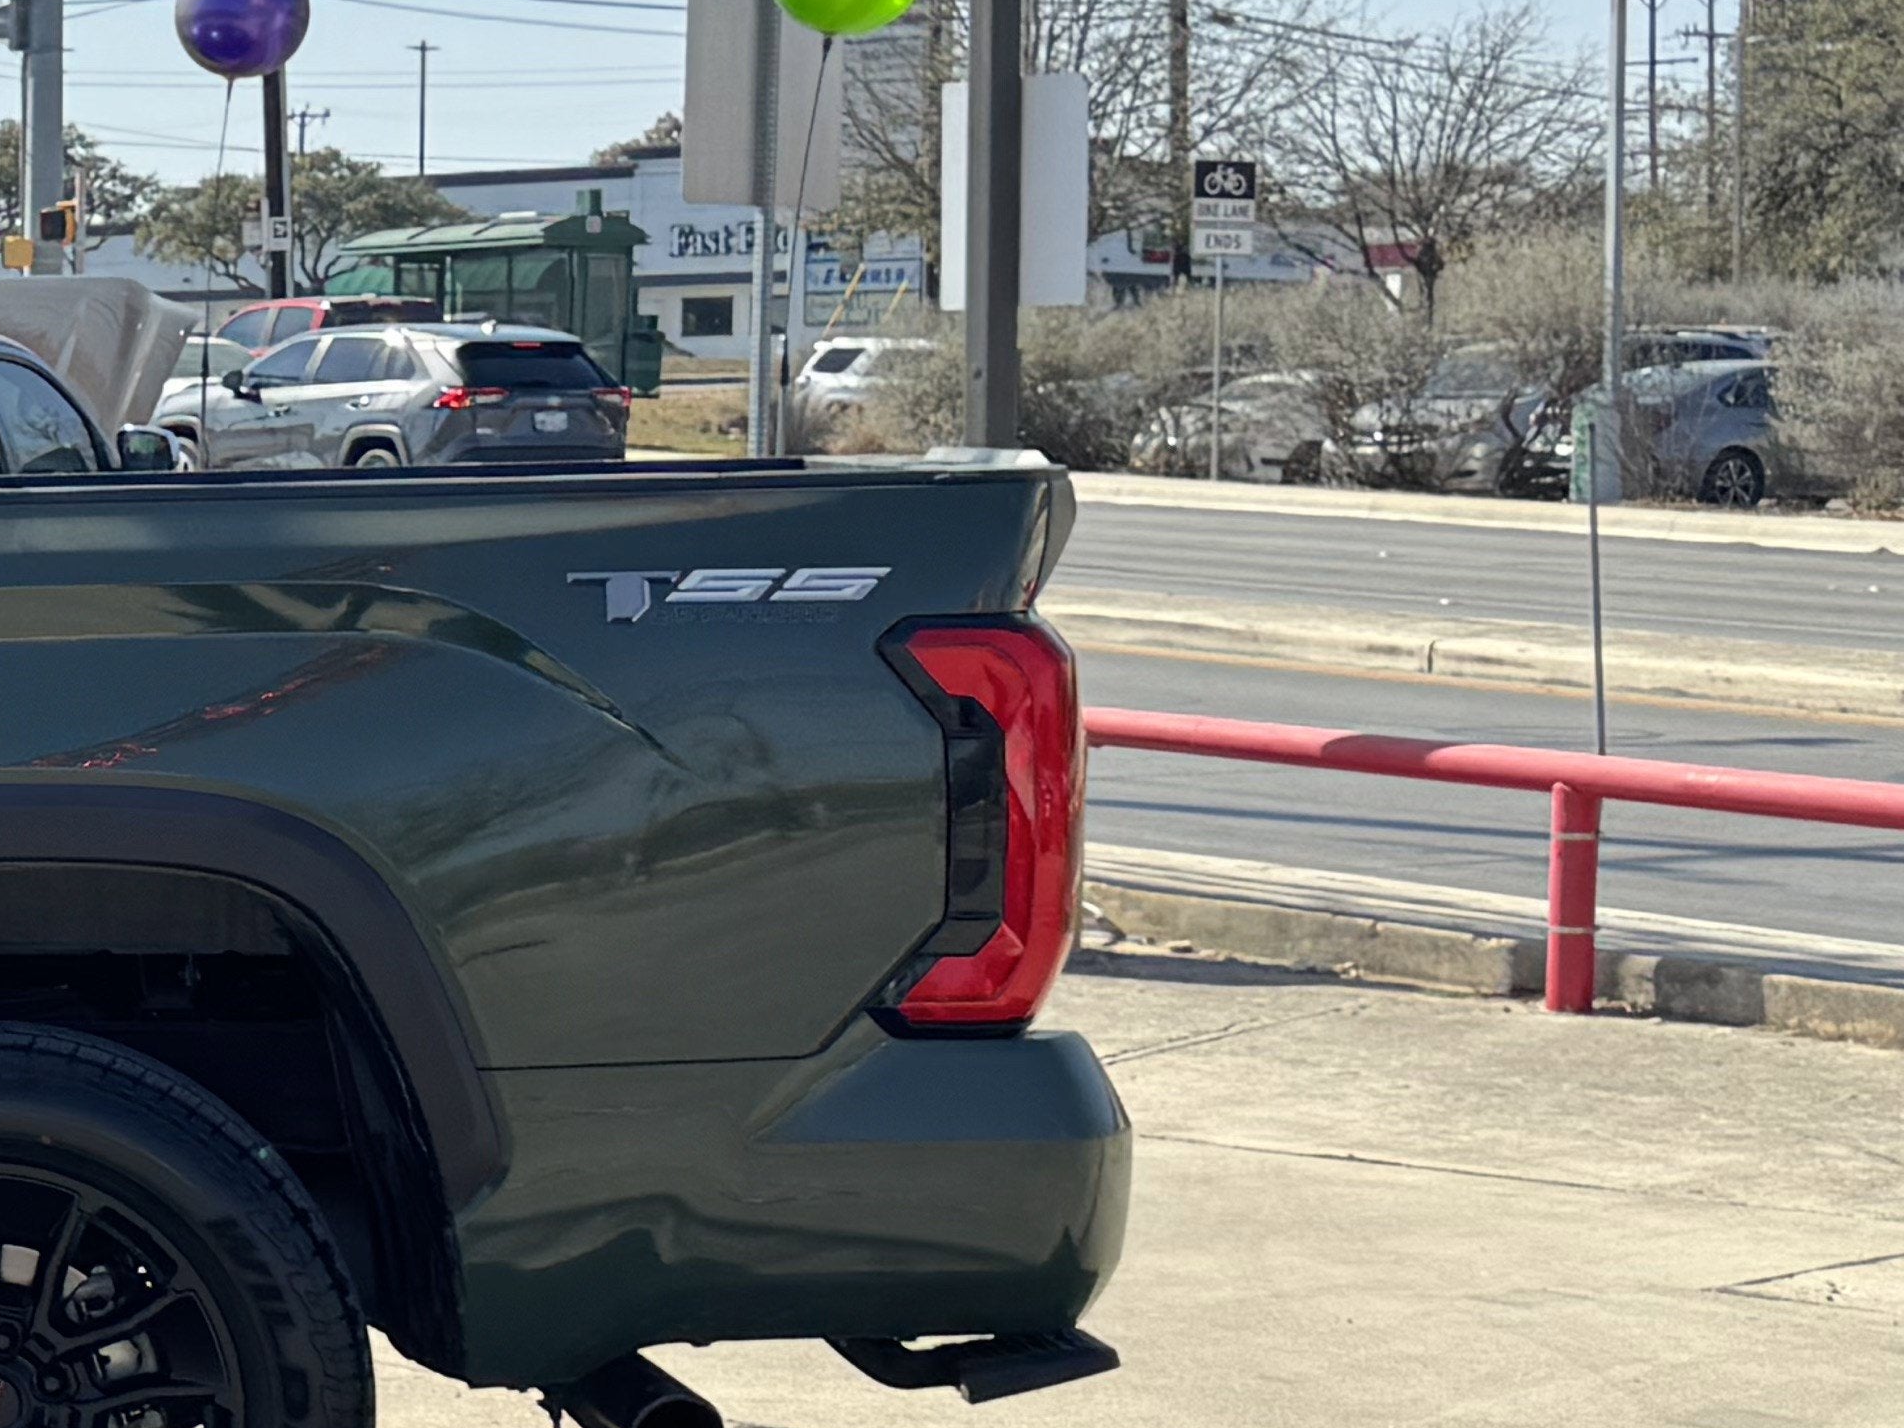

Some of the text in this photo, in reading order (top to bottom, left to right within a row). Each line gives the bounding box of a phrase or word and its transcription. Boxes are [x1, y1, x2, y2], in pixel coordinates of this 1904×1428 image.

[1197, 203, 1250, 219] BIKE LANE
[669, 222, 732, 258] Fast
[1204, 234, 1243, 250] ENDS
[565, 565, 893, 625] TSS
